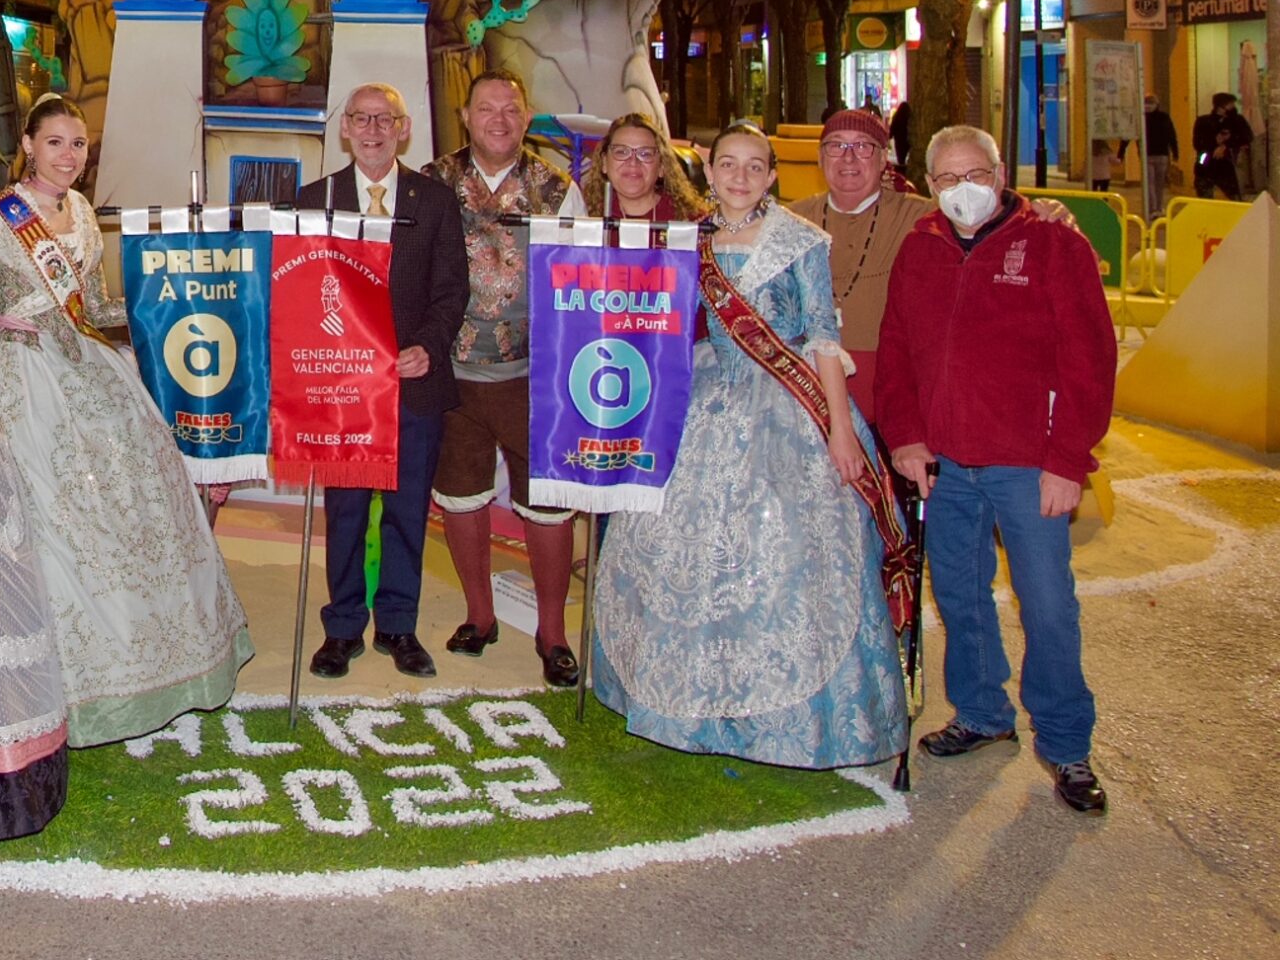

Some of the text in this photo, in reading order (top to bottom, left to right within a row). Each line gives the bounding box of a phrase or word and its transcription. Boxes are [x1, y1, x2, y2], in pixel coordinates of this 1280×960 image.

[142, 248, 254, 275] PREMI
[272, 249, 383, 286] PREMI GENERALITAT
[551, 263, 677, 292] PREMI
[158, 276, 237, 302] À Punt
[554, 289, 671, 313] LA COLLA
[636, 318, 668, 330] Punt
[183, 323, 220, 377] à
[291, 349, 375, 361] GENERALITAT
[292, 362, 374, 374] VALENCIANA
[588, 345, 631, 409] à
[305, 385, 359, 394] MILLOR FALLA
[307, 395, 360, 404] DEL MUNICIPI
[176, 411, 232, 429] FALLES
[296, 432, 373, 445] FALLES 2022
[578, 437, 642, 454] FALLES
[175, 755, 594, 839] 2022
